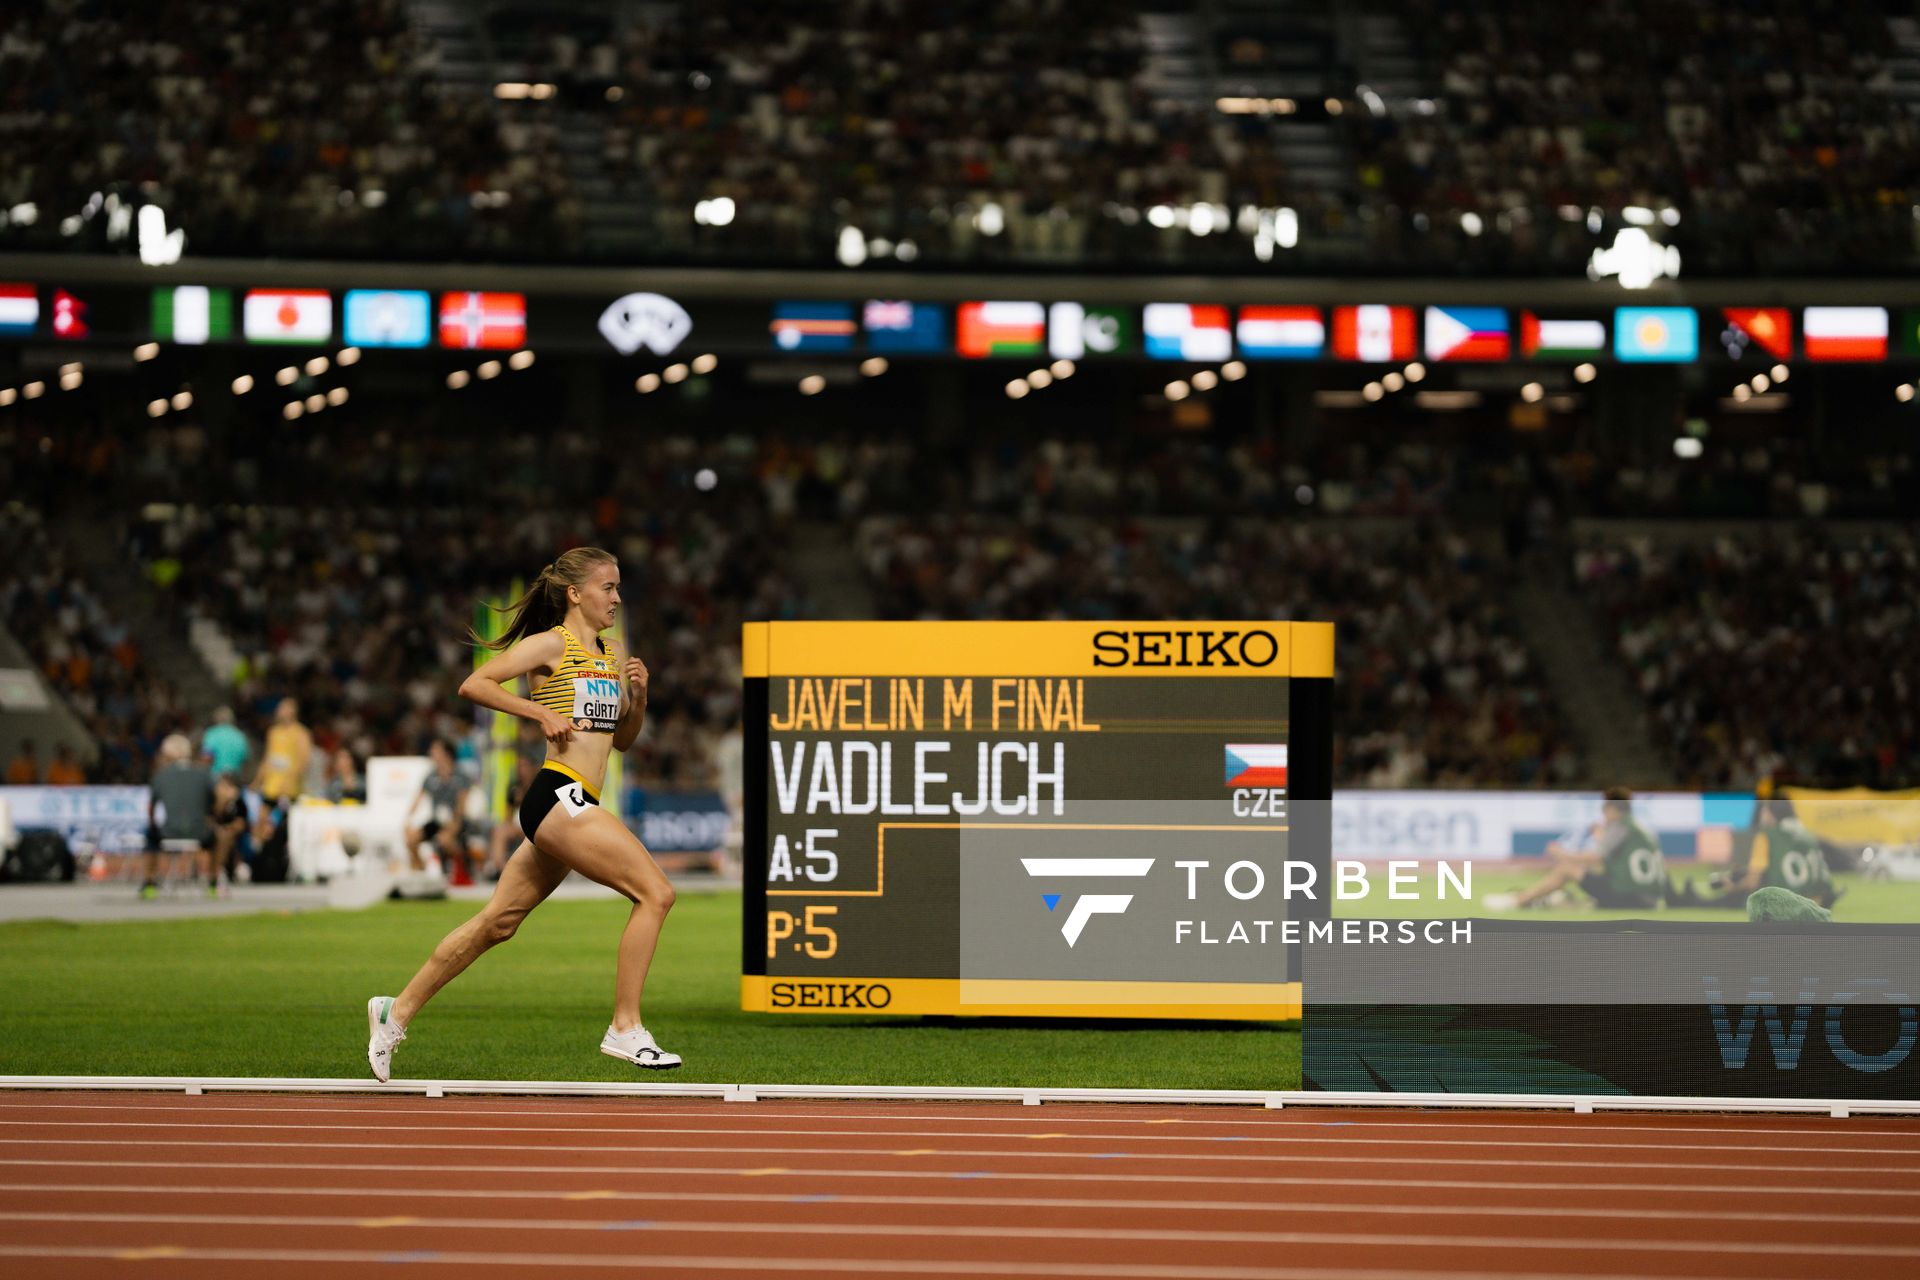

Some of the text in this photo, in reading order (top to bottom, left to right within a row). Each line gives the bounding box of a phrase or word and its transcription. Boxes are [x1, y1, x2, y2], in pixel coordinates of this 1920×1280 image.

[1093, 630, 1278, 667] SEIKO
[586, 679, 619, 697] NTN
[770, 678, 1101, 733] JAVELIN M FINAL
[770, 740, 1065, 816] VADLEJCH
[1232, 788, 1286, 818] CZE
[768, 828, 839, 882] A:5
[767, 905, 839, 960] P:5
[771, 983, 892, 1009] SEIKO
